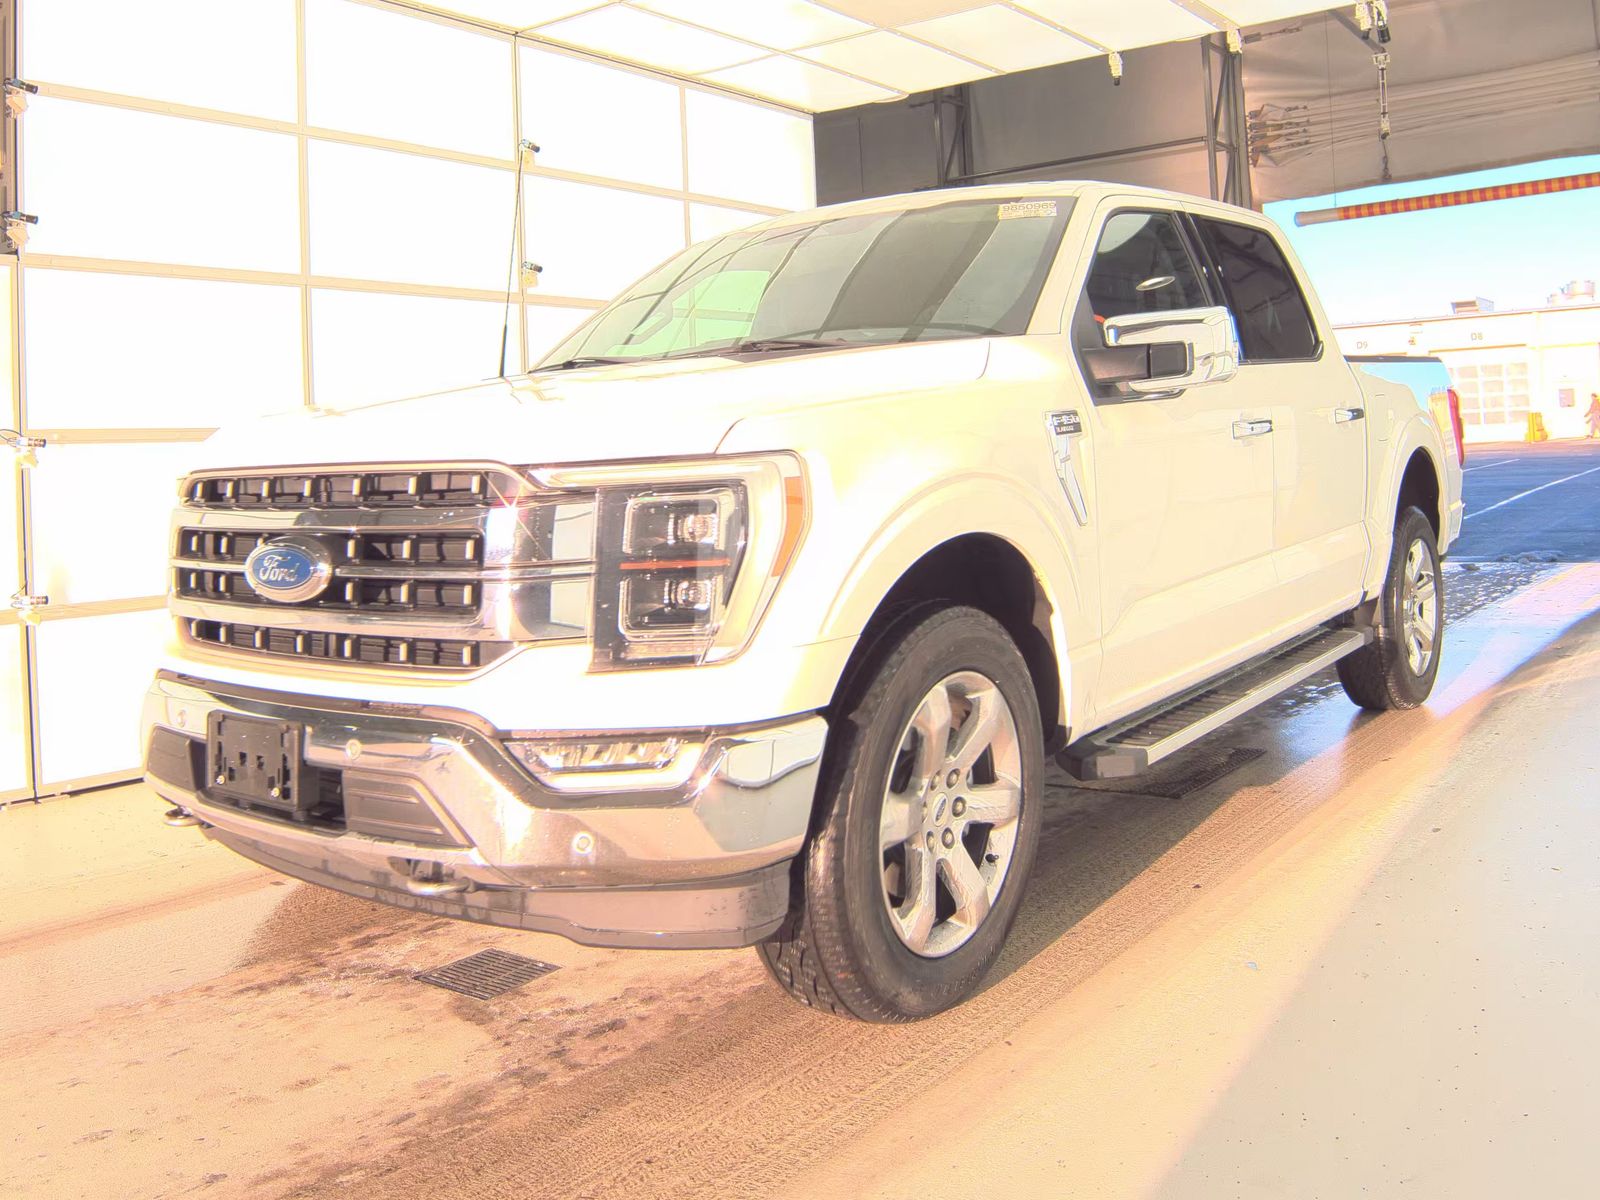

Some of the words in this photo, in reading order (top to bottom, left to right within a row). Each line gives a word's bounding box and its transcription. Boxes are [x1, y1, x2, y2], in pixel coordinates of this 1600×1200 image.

[1471, 332, 1483, 341] D8
[1356, 341, 1368, 350] D9
[260, 554, 300, 582] Ford
